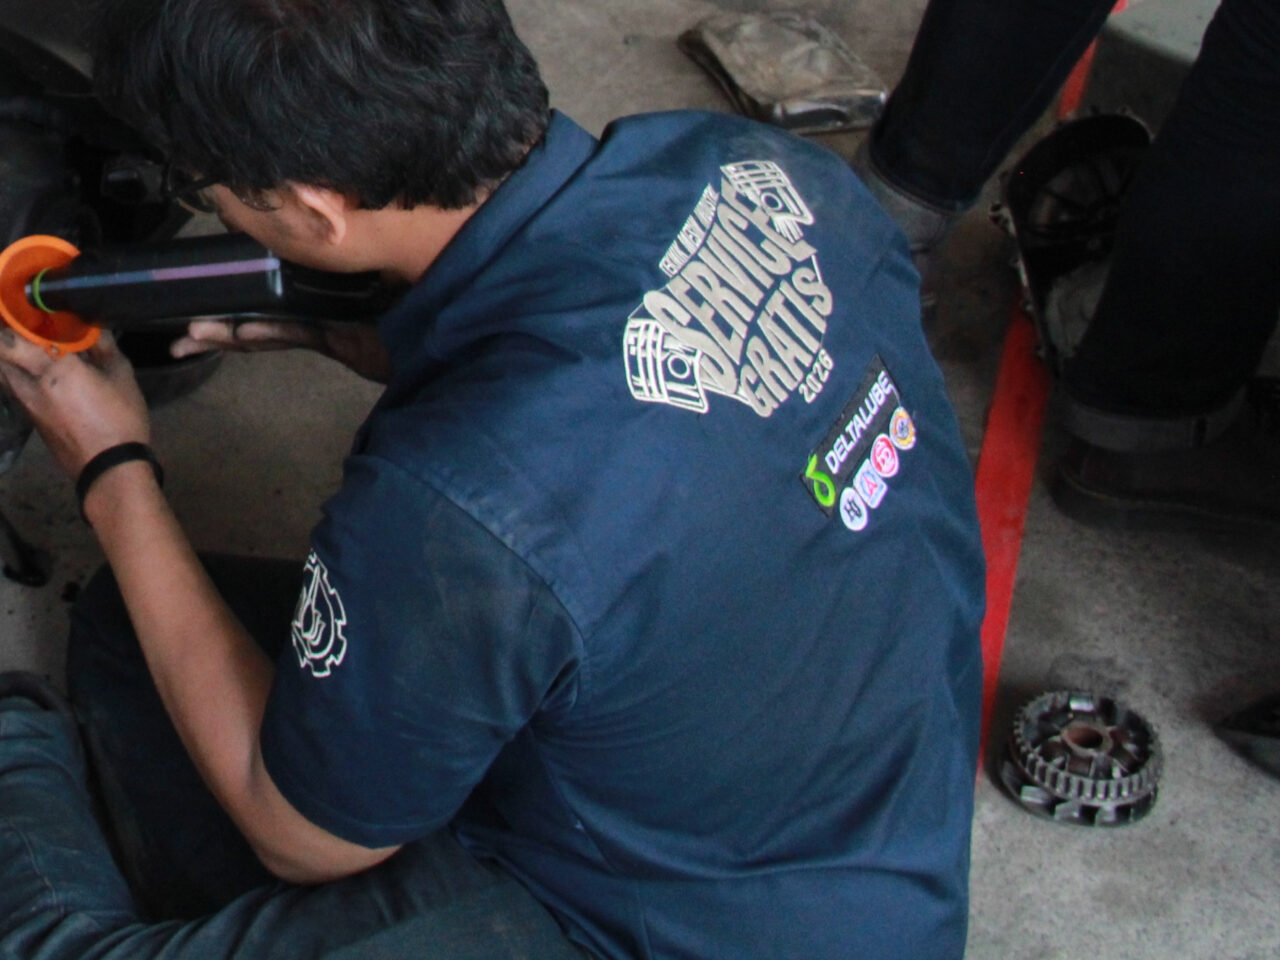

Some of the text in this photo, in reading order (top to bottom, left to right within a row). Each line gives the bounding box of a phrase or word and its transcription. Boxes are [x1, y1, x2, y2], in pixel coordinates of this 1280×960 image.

[643, 177, 818, 395] SERVICE
[740, 266, 834, 418] GRATIS
[798, 347, 834, 404] 2026
[824, 369, 894, 475] DELTALUBE
